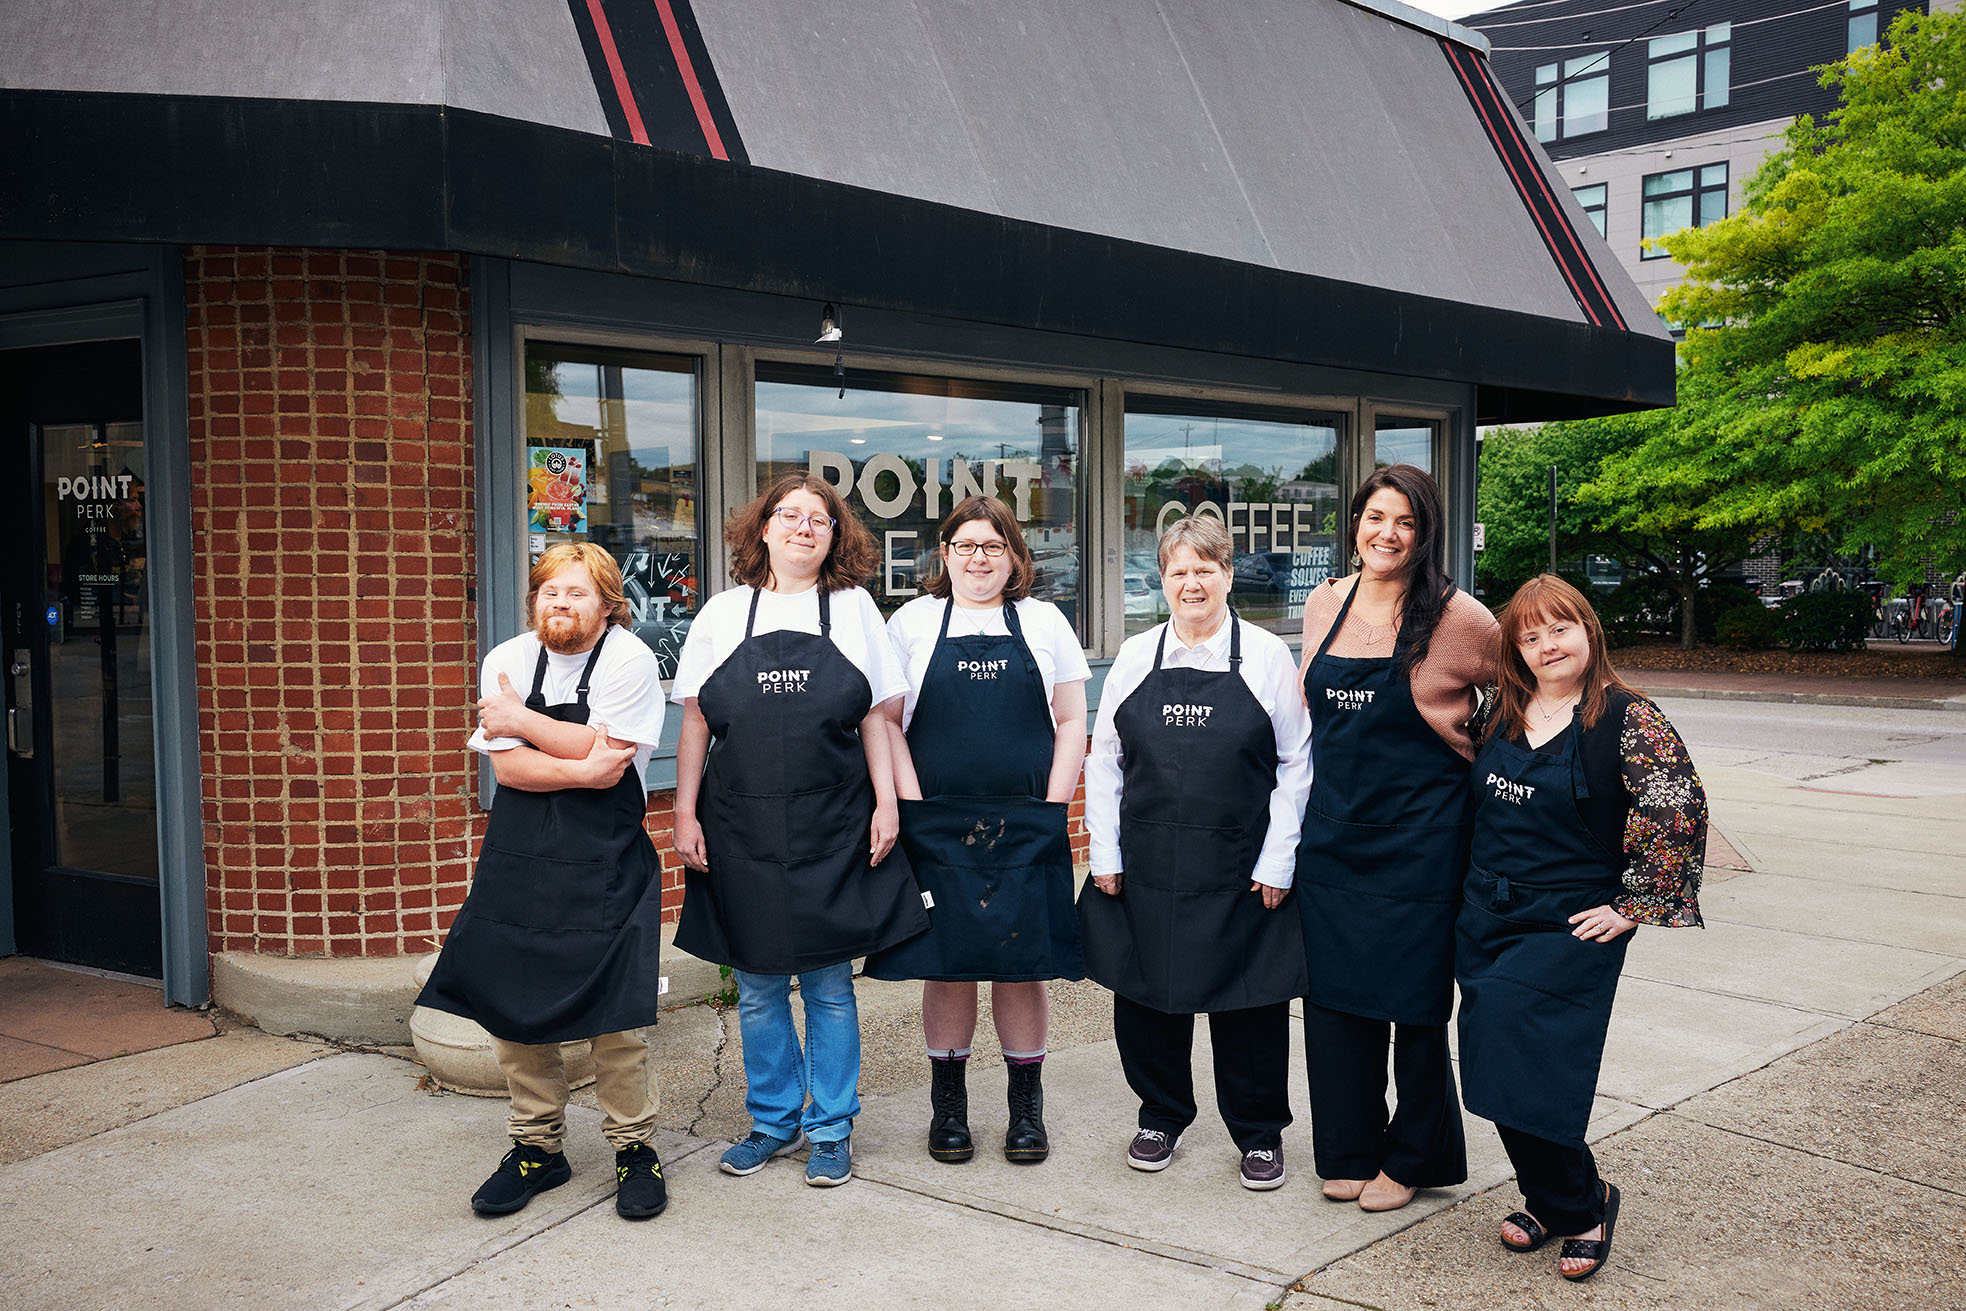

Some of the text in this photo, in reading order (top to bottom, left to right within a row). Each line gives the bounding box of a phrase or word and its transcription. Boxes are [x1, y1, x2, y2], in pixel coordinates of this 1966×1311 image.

[57, 475, 133, 500] POINT
[808, 450, 1042, 522] POINT
[77, 504, 114, 519] PERK
[1292, 546, 1330, 567] COFFEE
[78, 574, 119, 582] STORE HOURS
[1290, 567, 1328, 587] SOLVES
[957, 659, 1008, 672] POINT
[757, 669, 810, 683] POINT
[970, 672, 997, 680] PERK
[762, 681, 806, 694] PERK
[1326, 688, 1375, 703] POINT
[1162, 704, 1213, 717] POINT
[1337, 701, 1362, 710] PERK
[1165, 716, 1207, 727] PERK
[1486, 772, 1535, 799] POINT
[1494, 789, 1521, 805] PERK
